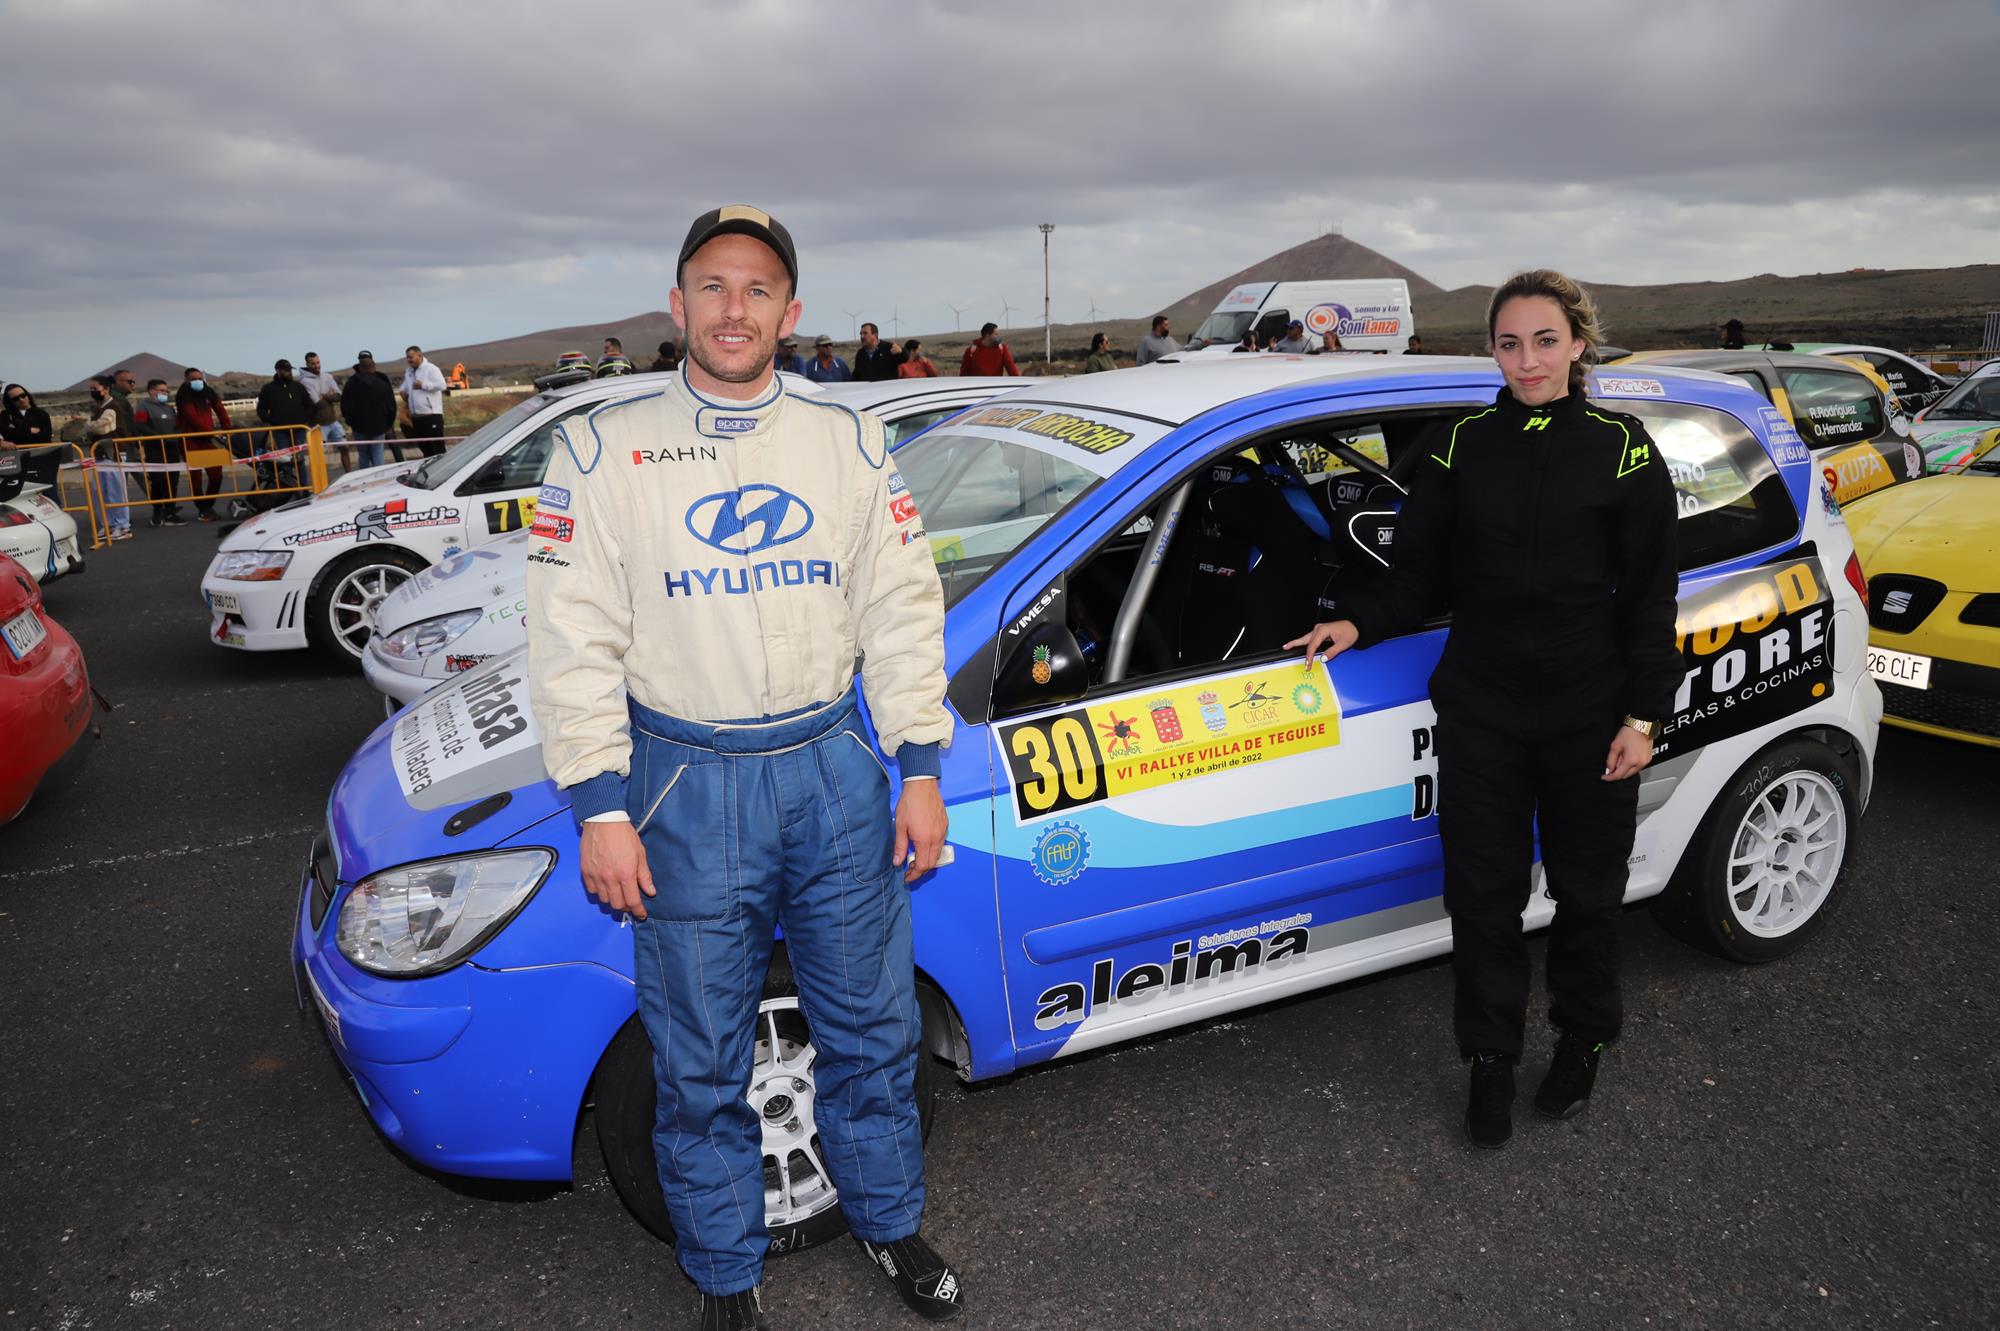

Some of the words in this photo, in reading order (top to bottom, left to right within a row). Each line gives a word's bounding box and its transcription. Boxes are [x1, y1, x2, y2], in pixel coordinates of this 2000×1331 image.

[1603, 385, 1662, 393] RALLYE
[1018, 412, 1135, 455] ARROCHA
[640, 446, 717, 463] RAHN
[1337, 485, 1362, 502] OMP
[283, 522, 357, 546] Valentin
[386, 506, 459, 523] Clavijo
[493, 501, 509, 531] 7
[664, 560, 841, 598] HYUNDAI
[1008, 587, 1062, 636] VIMESA
[1740, 655, 1823, 700] COCINAS
[1890, 657, 1923, 680] CLF
[1243, 706, 1279, 724] CICAR
[1012, 718, 1098, 810] 30
[1116, 767, 1133, 781] VI
[1140, 751, 1195, 775] RALLYE
[1198, 744, 1241, 761] VILLA
[1244, 737, 1262, 751] DE
[1268, 723, 1326, 746] TEGUISE
[1193, 765, 1205, 774] de
[1207, 760, 1227, 772] abril
[1229, 757, 1240, 767] de
[1242, 752, 1262, 764] 2022
[1198, 926, 1259, 949] Soluciones
[1260, 912, 1313, 935] Integrales
[1034, 926, 1310, 1031] aleima
[880, 1250, 897, 1278] OMP
[938, 1274, 958, 1300] OMP
